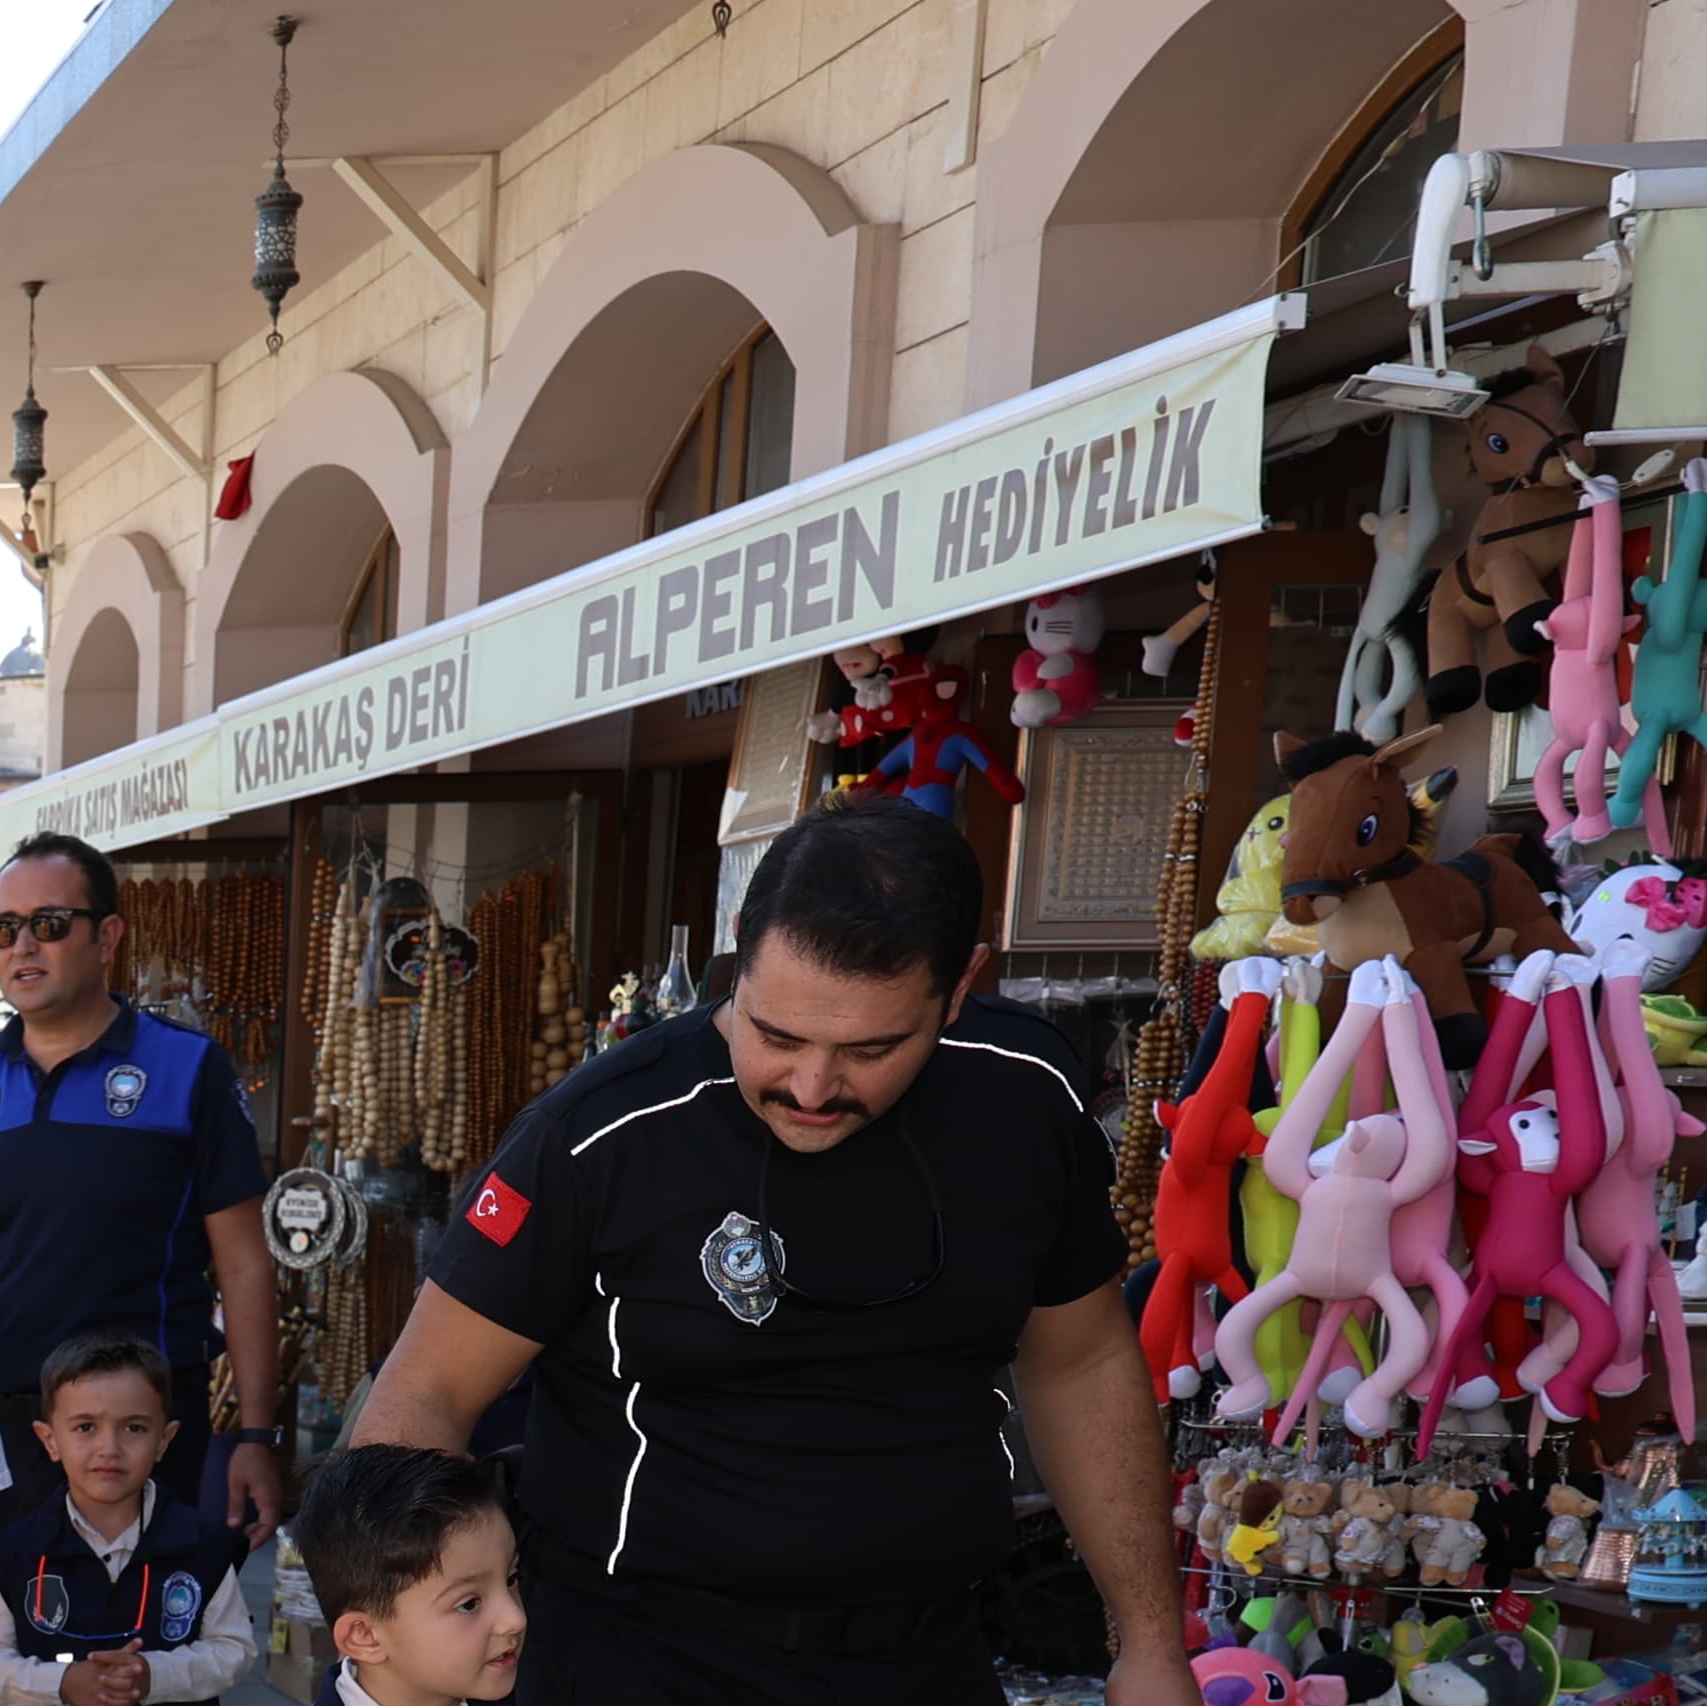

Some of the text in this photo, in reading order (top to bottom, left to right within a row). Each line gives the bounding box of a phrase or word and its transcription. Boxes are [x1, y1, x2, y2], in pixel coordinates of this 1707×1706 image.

[574, 393, 1217, 700] ALPEREN HEDİYELİK
[234, 634, 469, 794] KARAKAŞ DERİ
[84, 782, 117, 839] SATIŞ
[121, 758, 189, 826] MAĞAZASI
